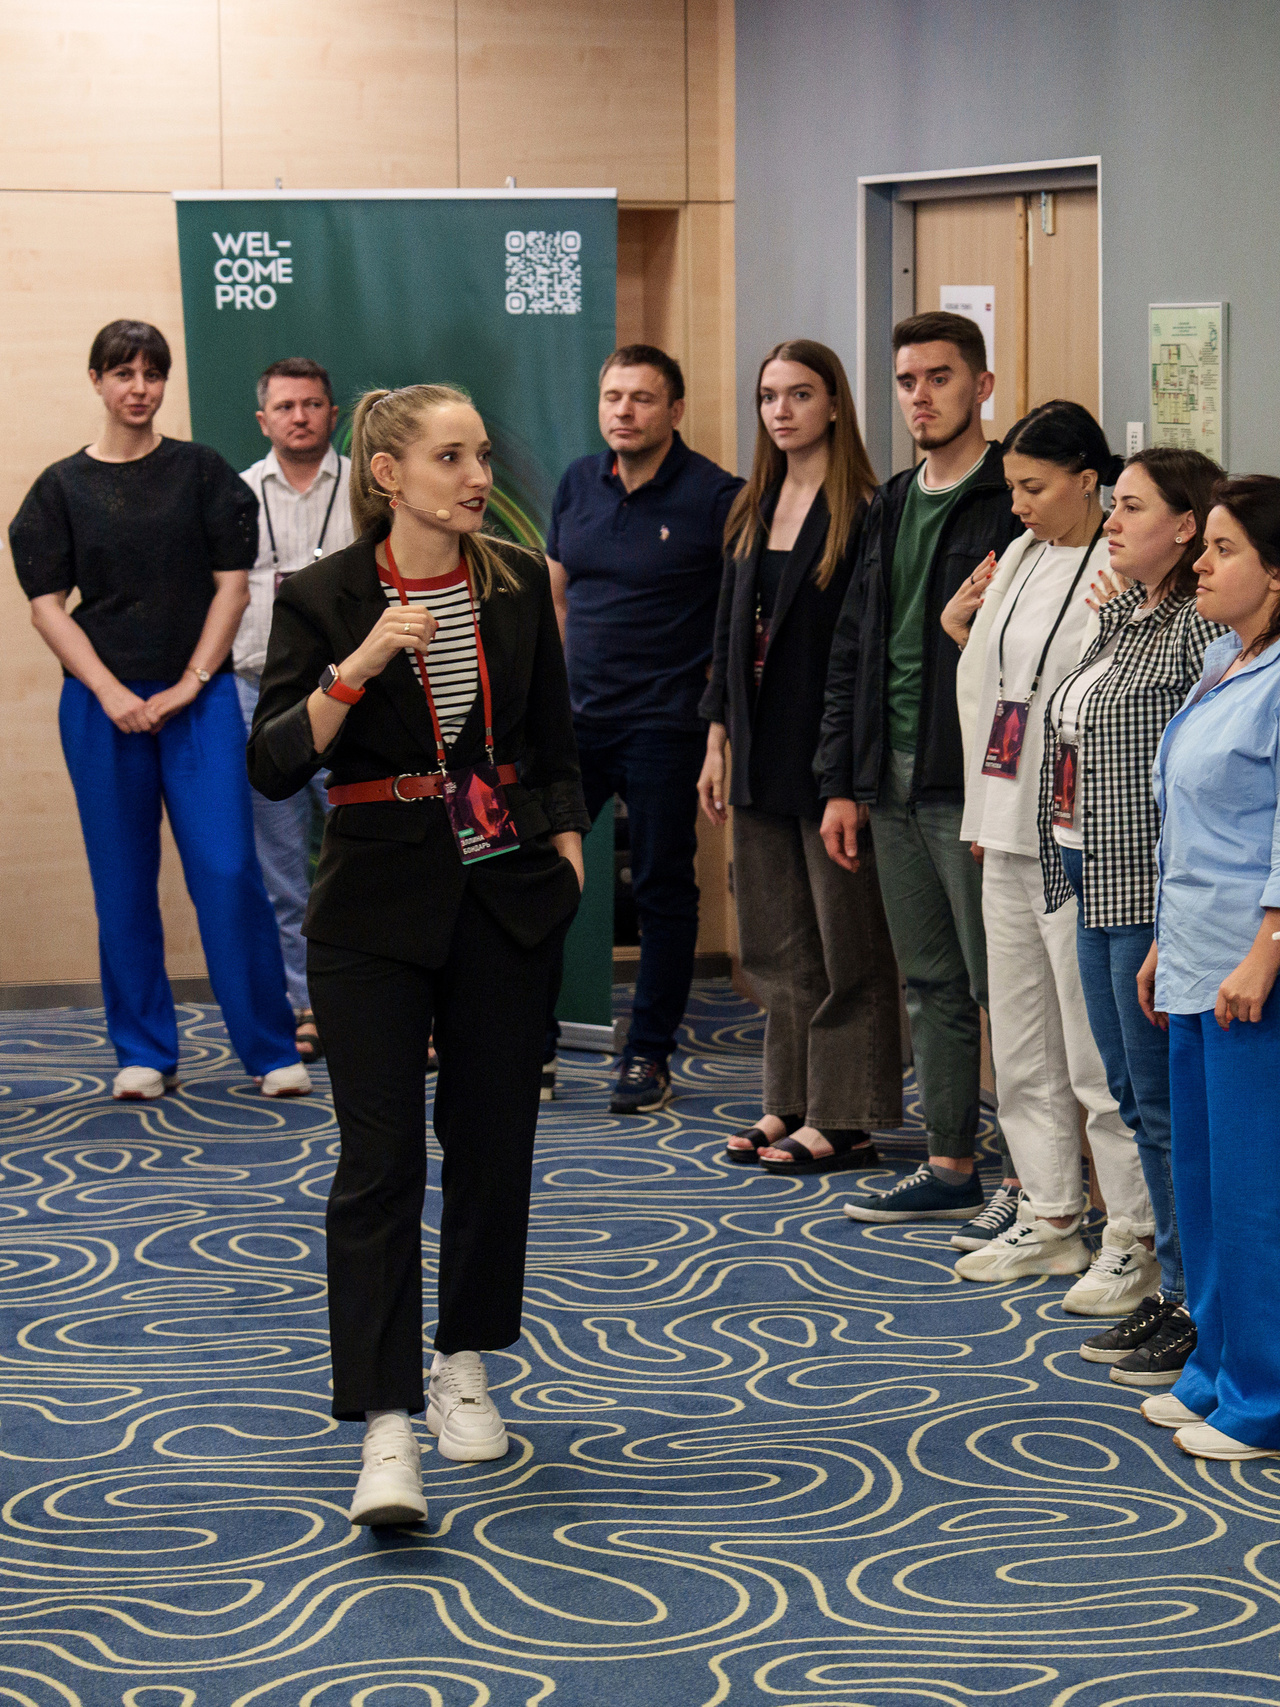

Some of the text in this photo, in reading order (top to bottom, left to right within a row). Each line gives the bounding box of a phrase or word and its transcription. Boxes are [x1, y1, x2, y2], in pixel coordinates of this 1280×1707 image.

[213, 231, 292, 257] WEL-
[214, 258, 293, 284] COME
[215, 284, 277, 311] PRO
